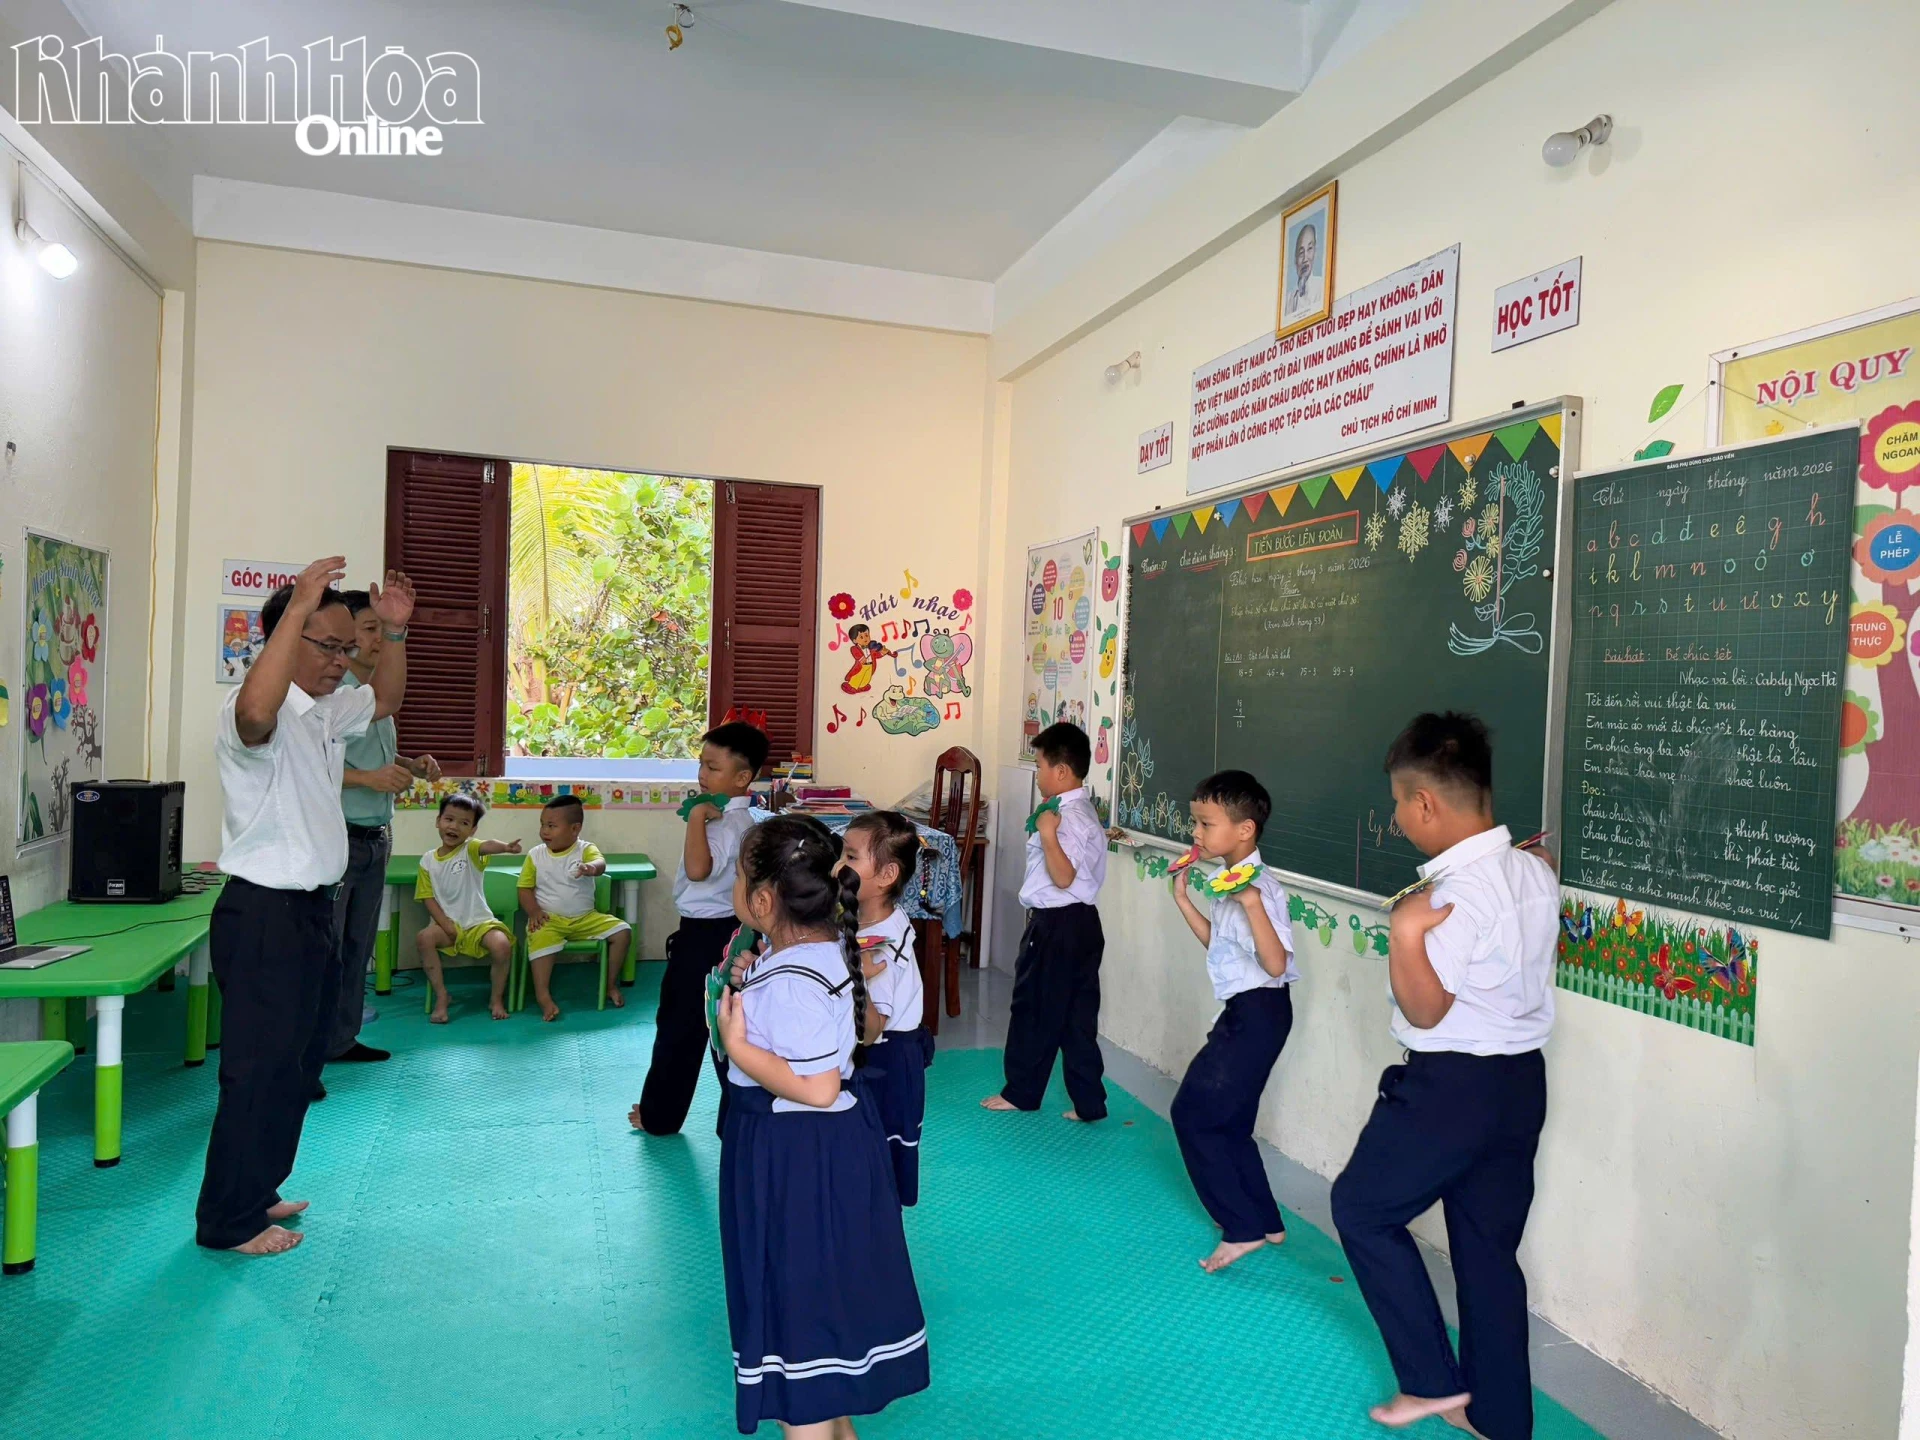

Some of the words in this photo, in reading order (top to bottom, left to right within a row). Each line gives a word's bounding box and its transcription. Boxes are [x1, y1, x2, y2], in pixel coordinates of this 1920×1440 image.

[1497, 296, 1533, 339] HỌC
[1538, 270, 1574, 320] TỐT
[1212, 367, 1230, 386] SÔNG
[1232, 358, 1248, 378] VIỆT
[1249, 351, 1265, 370] NAM
[1267, 341, 1278, 362] CÓ
[1337, 308, 1355, 332] ĐẸP
[1357, 299, 1377, 321] HAY
[1379, 282, 1418, 312] KHÔNG,
[1421, 269, 1444, 294] DÂN
[1194, 399, 1206, 417] TỘC
[1208, 392, 1222, 411] VIỆT
[1223, 386, 1239, 403] NAM
[1240, 377, 1251, 396] CÓ
[1251, 370, 1272, 392] BƯỚC
[1287, 357, 1301, 377] ĐÀI
[1303, 349, 1324, 370] VINH
[1326, 336, 1357, 361] QUANG
[1359, 321, 1372, 347] ĐỂ
[1374, 316, 1401, 342] SÁNH
[1405, 308, 1421, 329] VAI
[1756, 370, 1816, 405] NỘI
[1829, 348, 1910, 391] QUY
[1192, 420, 1206, 438] CÁC
[1206, 413, 1229, 432] CƯỜNG
[1230, 400, 1250, 423] QUỐC
[1251, 397, 1268, 416] NĂM
[1268, 387, 1290, 409] CHÂU
[1291, 378, 1315, 401] ĐƯỢC
[1316, 371, 1337, 391] HAY
[1336, 360, 1371, 383] KHÔNG,
[1374, 345, 1405, 369] CHÍNH
[1408, 333, 1420, 356] LÀ
[1192, 442, 1205, 461] MỘT
[1206, 433, 1224, 455] PHẦN
[1246, 423, 1267, 441] CÔNG
[1268, 415, 1285, 435] HỌC
[1287, 407, 1302, 429] TẬP
[1304, 398, 1322, 421] CỦA
[1324, 393, 1342, 414] CÁC
[1341, 417, 1358, 437] CHỦ
[1361, 415, 1379, 434] TỊCH
[1382, 405, 1394, 426] HỒ
[1396, 401, 1411, 421] CHÍ
[1413, 395, 1437, 413] MINH
[1140, 440, 1154, 466] DẠY
[1155, 427, 1170, 458] TỐT
[1882, 447, 1920, 461] NGOAN
[1886, 431, 1919, 445] CHĂM
[1592, 482, 1624, 506] Thứ
[1657, 480, 1690, 506] ngày
[1707, 468, 1747, 497] tháng
[1763, 466, 1799, 481] năm
[1801, 462, 1833, 477] 2026
[1586, 539, 1598, 552] a
[1609, 520, 1620, 549] b
[1629, 533, 1640, 547] c
[1651, 519, 1667, 545] d
[1680, 515, 1694, 541] đ
[1710, 523, 1719, 538] e
[1736, 515, 1746, 535] ê
[1768, 517, 1782, 550] g
[1805, 492, 1826, 526] h
[1888, 530, 1902, 545] LỄ
[1254, 534, 1273, 555] TIẾN
[1275, 530, 1296, 549] BƯỚC
[1298, 527, 1316, 546] LÊN
[1319, 524, 1343, 542] ĐOÀN
[1880, 545, 1911, 560] PHÉP
[231, 567, 263, 588] GÓC
[1348, 556, 1371, 571] 2026
[1589, 567, 1598, 585] i
[1606, 553, 1620, 584] k
[1629, 550, 1642, 581] l
[1654, 564, 1676, 579] m
[1691, 561, 1707, 576] n
[1724, 558, 1736, 574] o
[1754, 549, 1767, 571] ô
[1801, 548, 1815, 567] ơ
[859, 593, 898, 622] Hát
[1053, 596, 1064, 621] 10
[1610, 603, 1620, 627] q
[1683, 593, 1695, 613] t
[1709, 597, 1727, 611] u
[1740, 590, 1759, 610] ư
[1770, 592, 1784, 608] v
[1793, 591, 1810, 607] x
[1821, 590, 1838, 625] y
[1850, 621, 1887, 633] TRUNG
[1853, 634, 1882, 648] THỰC
[1604, 648, 1623, 661] Bài
[1665, 646, 1681, 661] Bé
[1682, 643, 1710, 661] chúc
[1714, 643, 1733, 661] tết
[1679, 667, 1710, 687] Nhạc
[1712, 672, 1729, 685] và
[1756, 671, 1792, 697] Cabdy
[1794, 671, 1821, 696] Ngọc
[1821, 671, 1837, 687] Hà
[1585, 692, 1602, 707] Tết
[1604, 693, 1623, 707] đến
[1624, 691, 1641, 708] rồi
[1644, 695, 1663, 708] vui
[1666, 691, 1693, 712] thật
[1697, 692, 1710, 710] là
[1714, 698, 1737, 711] vui
[1586, 715, 1604, 729] Em
[1607, 719, 1629, 733] mặc
[1631, 717, 1643, 730] áo
[1647, 716, 1667, 732] mới
[1671, 719, 1683, 733] đi
[1737, 719, 1755, 741] họ
[1759, 719, 1799, 750] hàng
[1585, 736, 1604, 751] Em
[1606, 735, 1630, 754] chúc
[1633, 741, 1655, 763] ông
[1657, 738, 1673, 757] bà
[1736, 744, 1763, 767] thật
[1766, 743, 1783, 764] là
[1789, 746, 1818, 768] lâu
